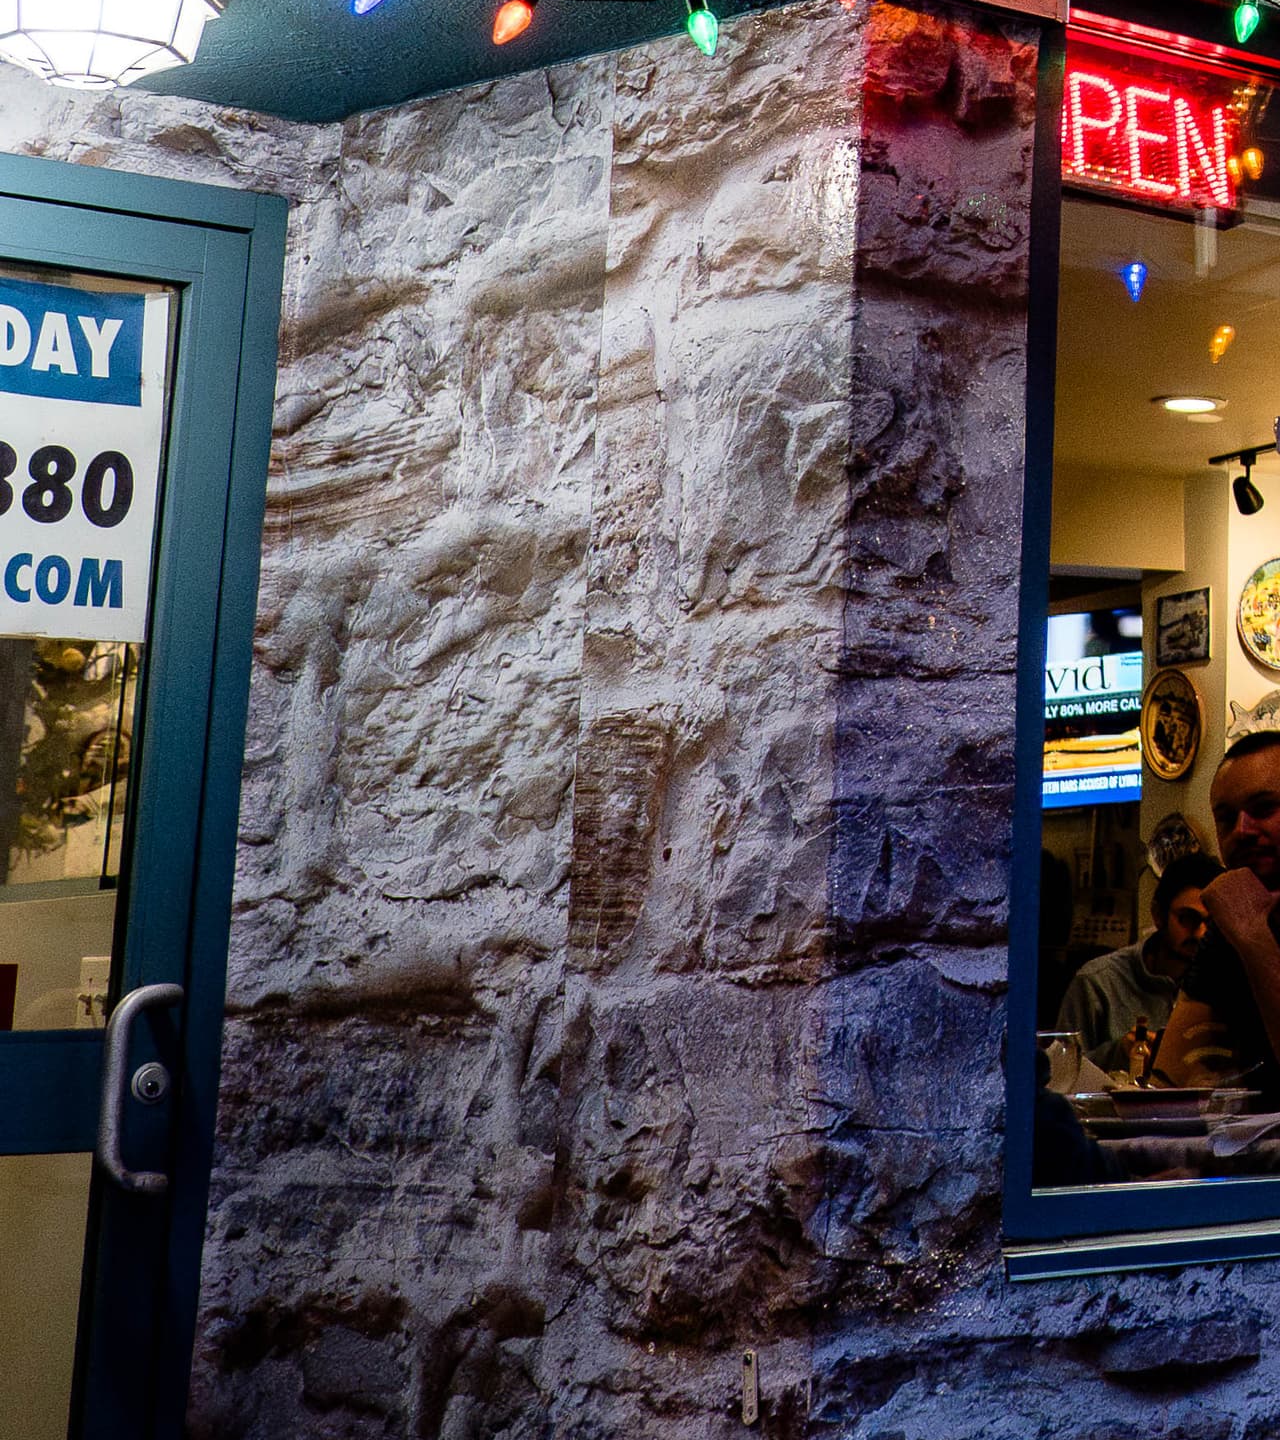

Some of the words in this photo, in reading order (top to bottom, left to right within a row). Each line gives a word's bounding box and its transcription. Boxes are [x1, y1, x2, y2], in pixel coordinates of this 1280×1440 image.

[1061, 71, 1230, 205] PEN
[0, 302, 124, 379] DAY
[1086, 699, 1119, 714] MORE
